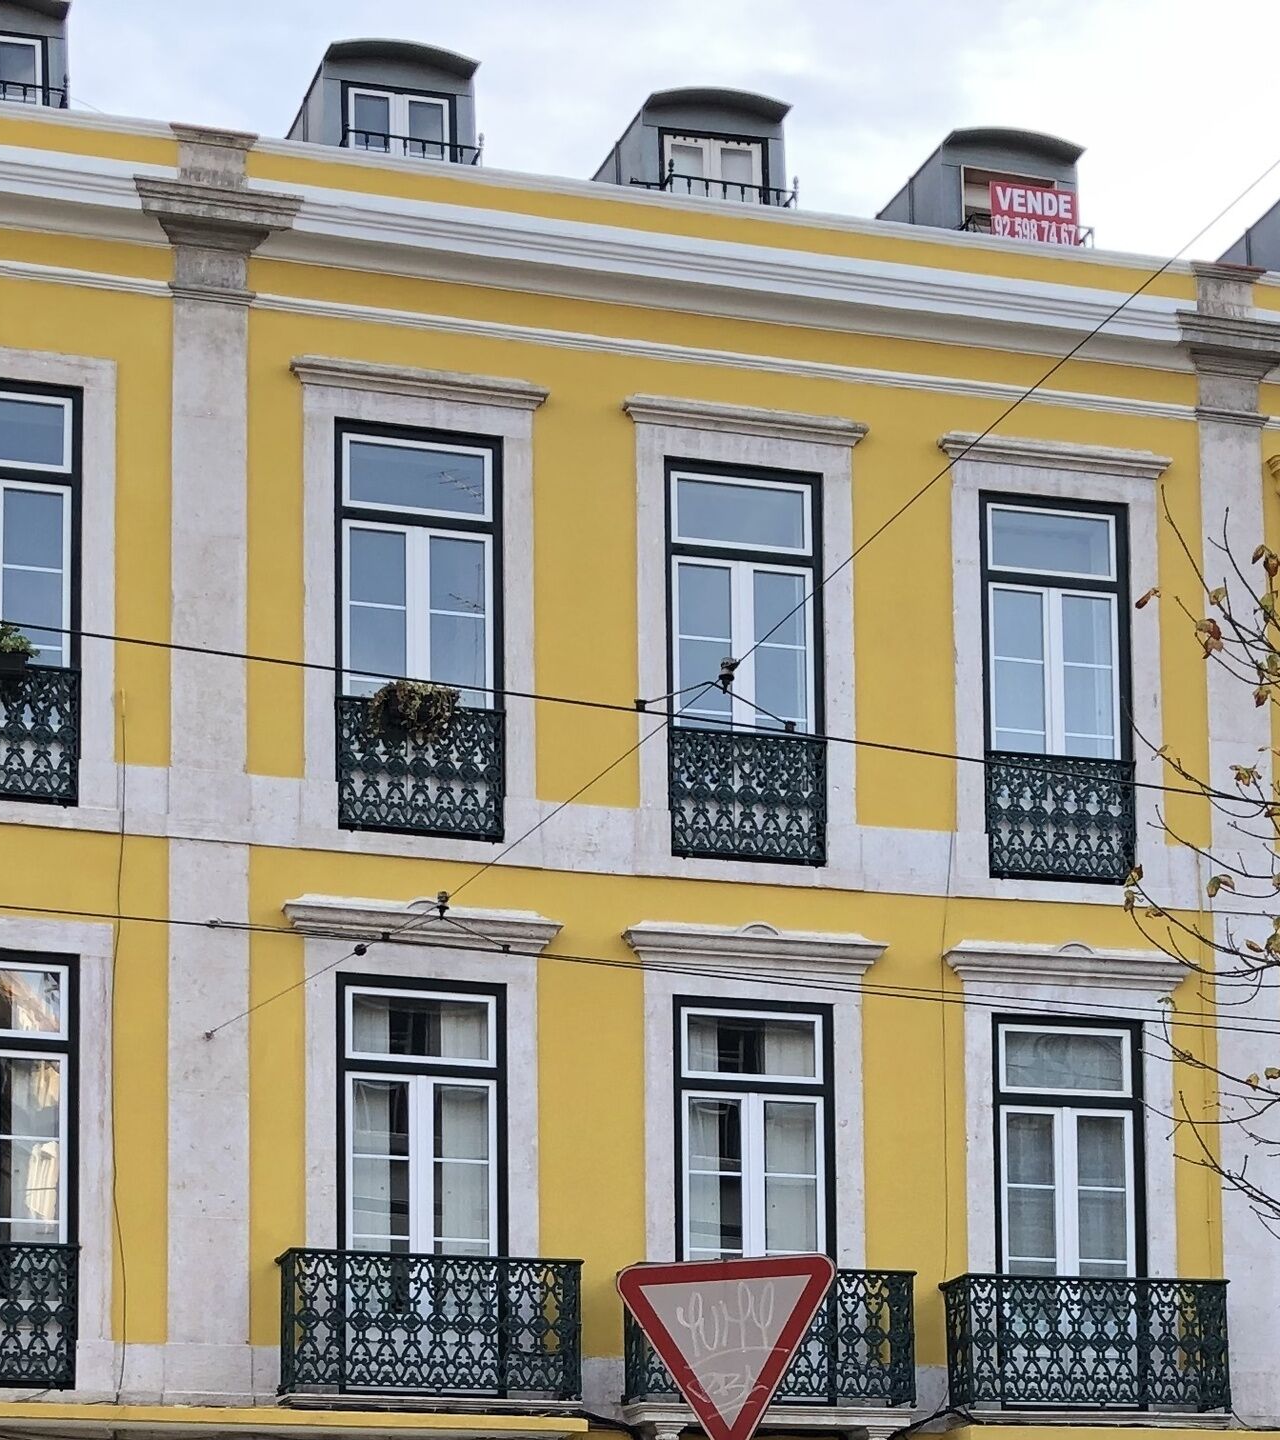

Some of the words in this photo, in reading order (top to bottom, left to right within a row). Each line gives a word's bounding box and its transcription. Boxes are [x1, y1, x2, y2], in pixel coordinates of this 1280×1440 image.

[995, 186, 1073, 219] VENDE
[994, 214, 1011, 238] 92
[1014, 217, 1039, 241] 598
[1041, 220, 1058, 245] 74
[1060, 223, 1078, 246] 67
